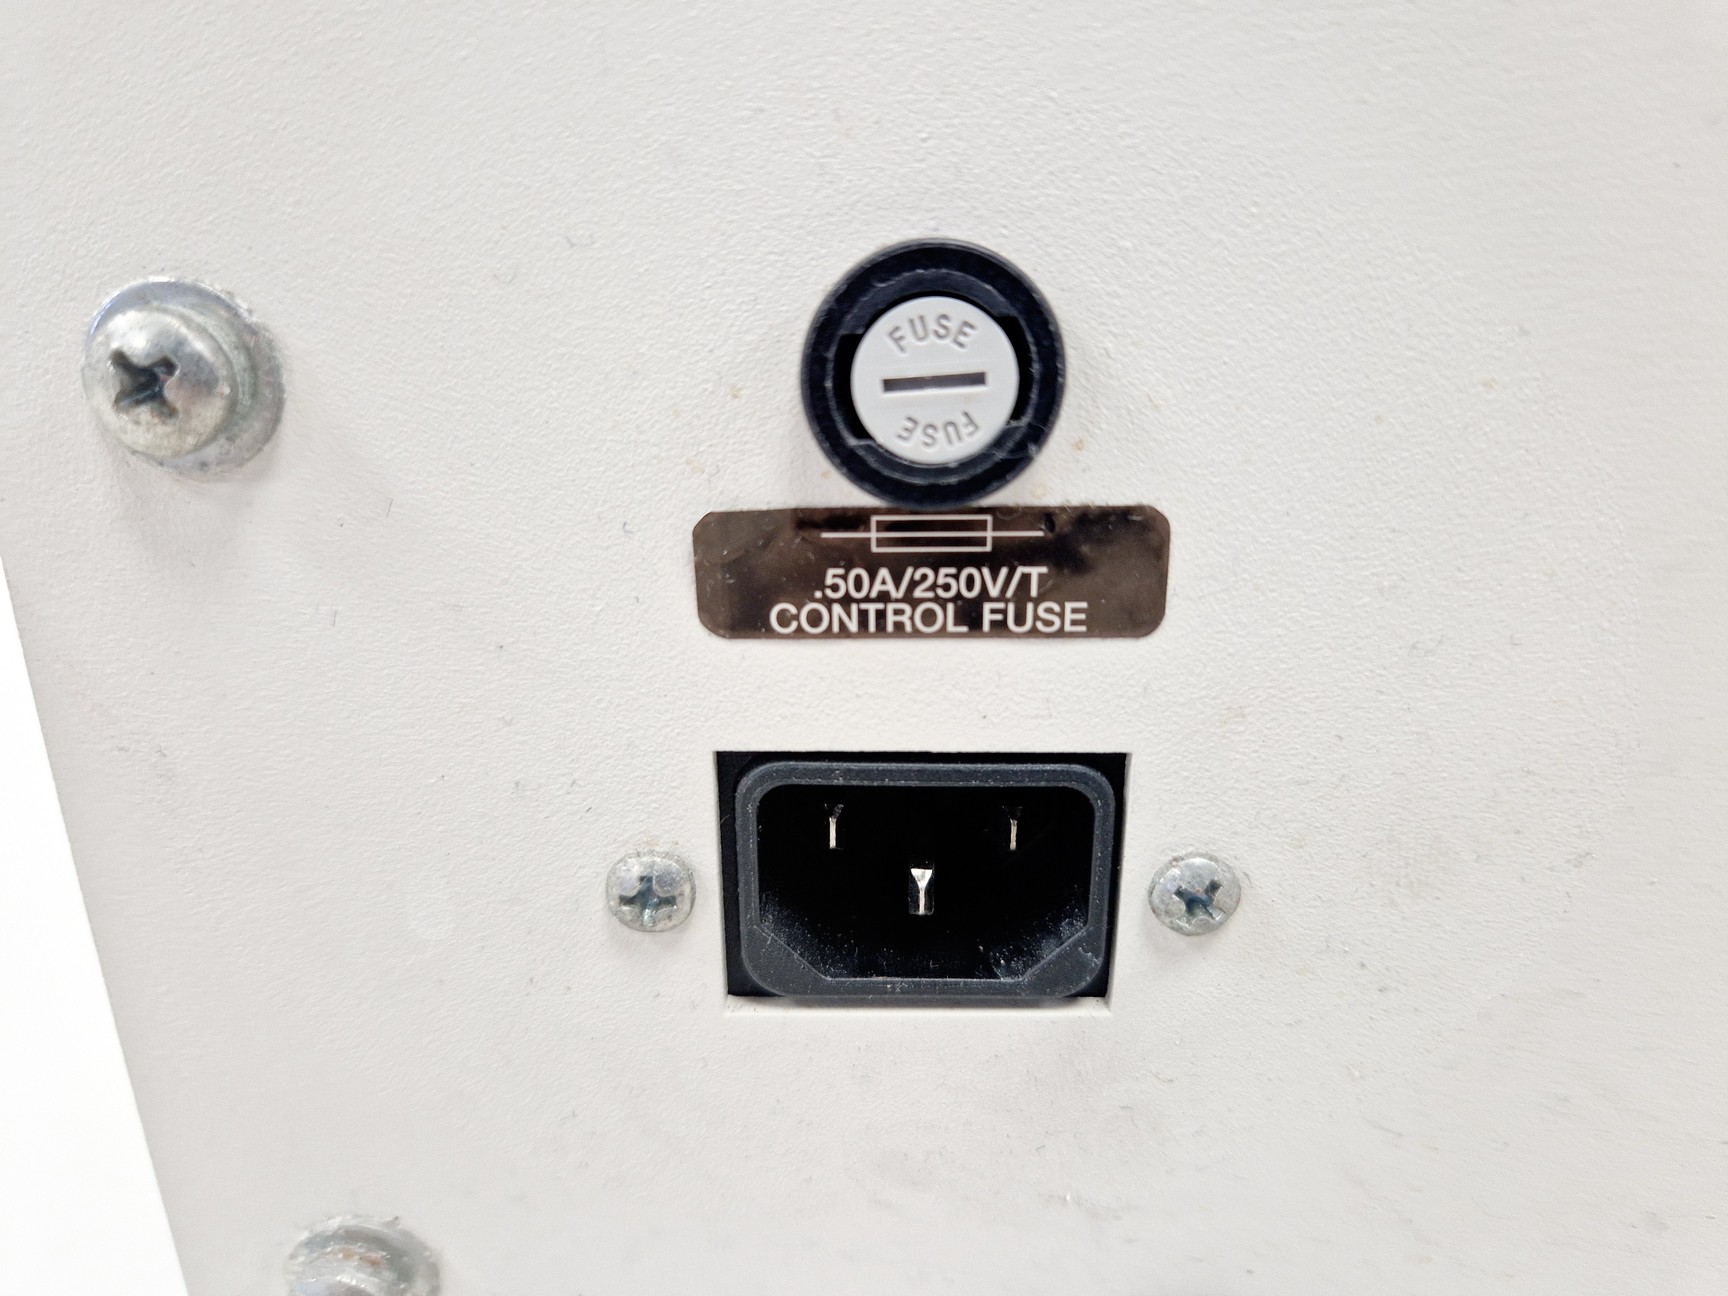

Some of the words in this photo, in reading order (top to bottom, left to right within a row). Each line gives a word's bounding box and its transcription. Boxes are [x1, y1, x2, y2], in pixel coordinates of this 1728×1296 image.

[887, 314, 978, 354] FUSE
[896, 410, 980, 447] FUSE
[813, 566, 1048, 600] .50A/250V/T
[769, 602, 969, 634] CONTROL
[983, 601, 1088, 633] FUSE
